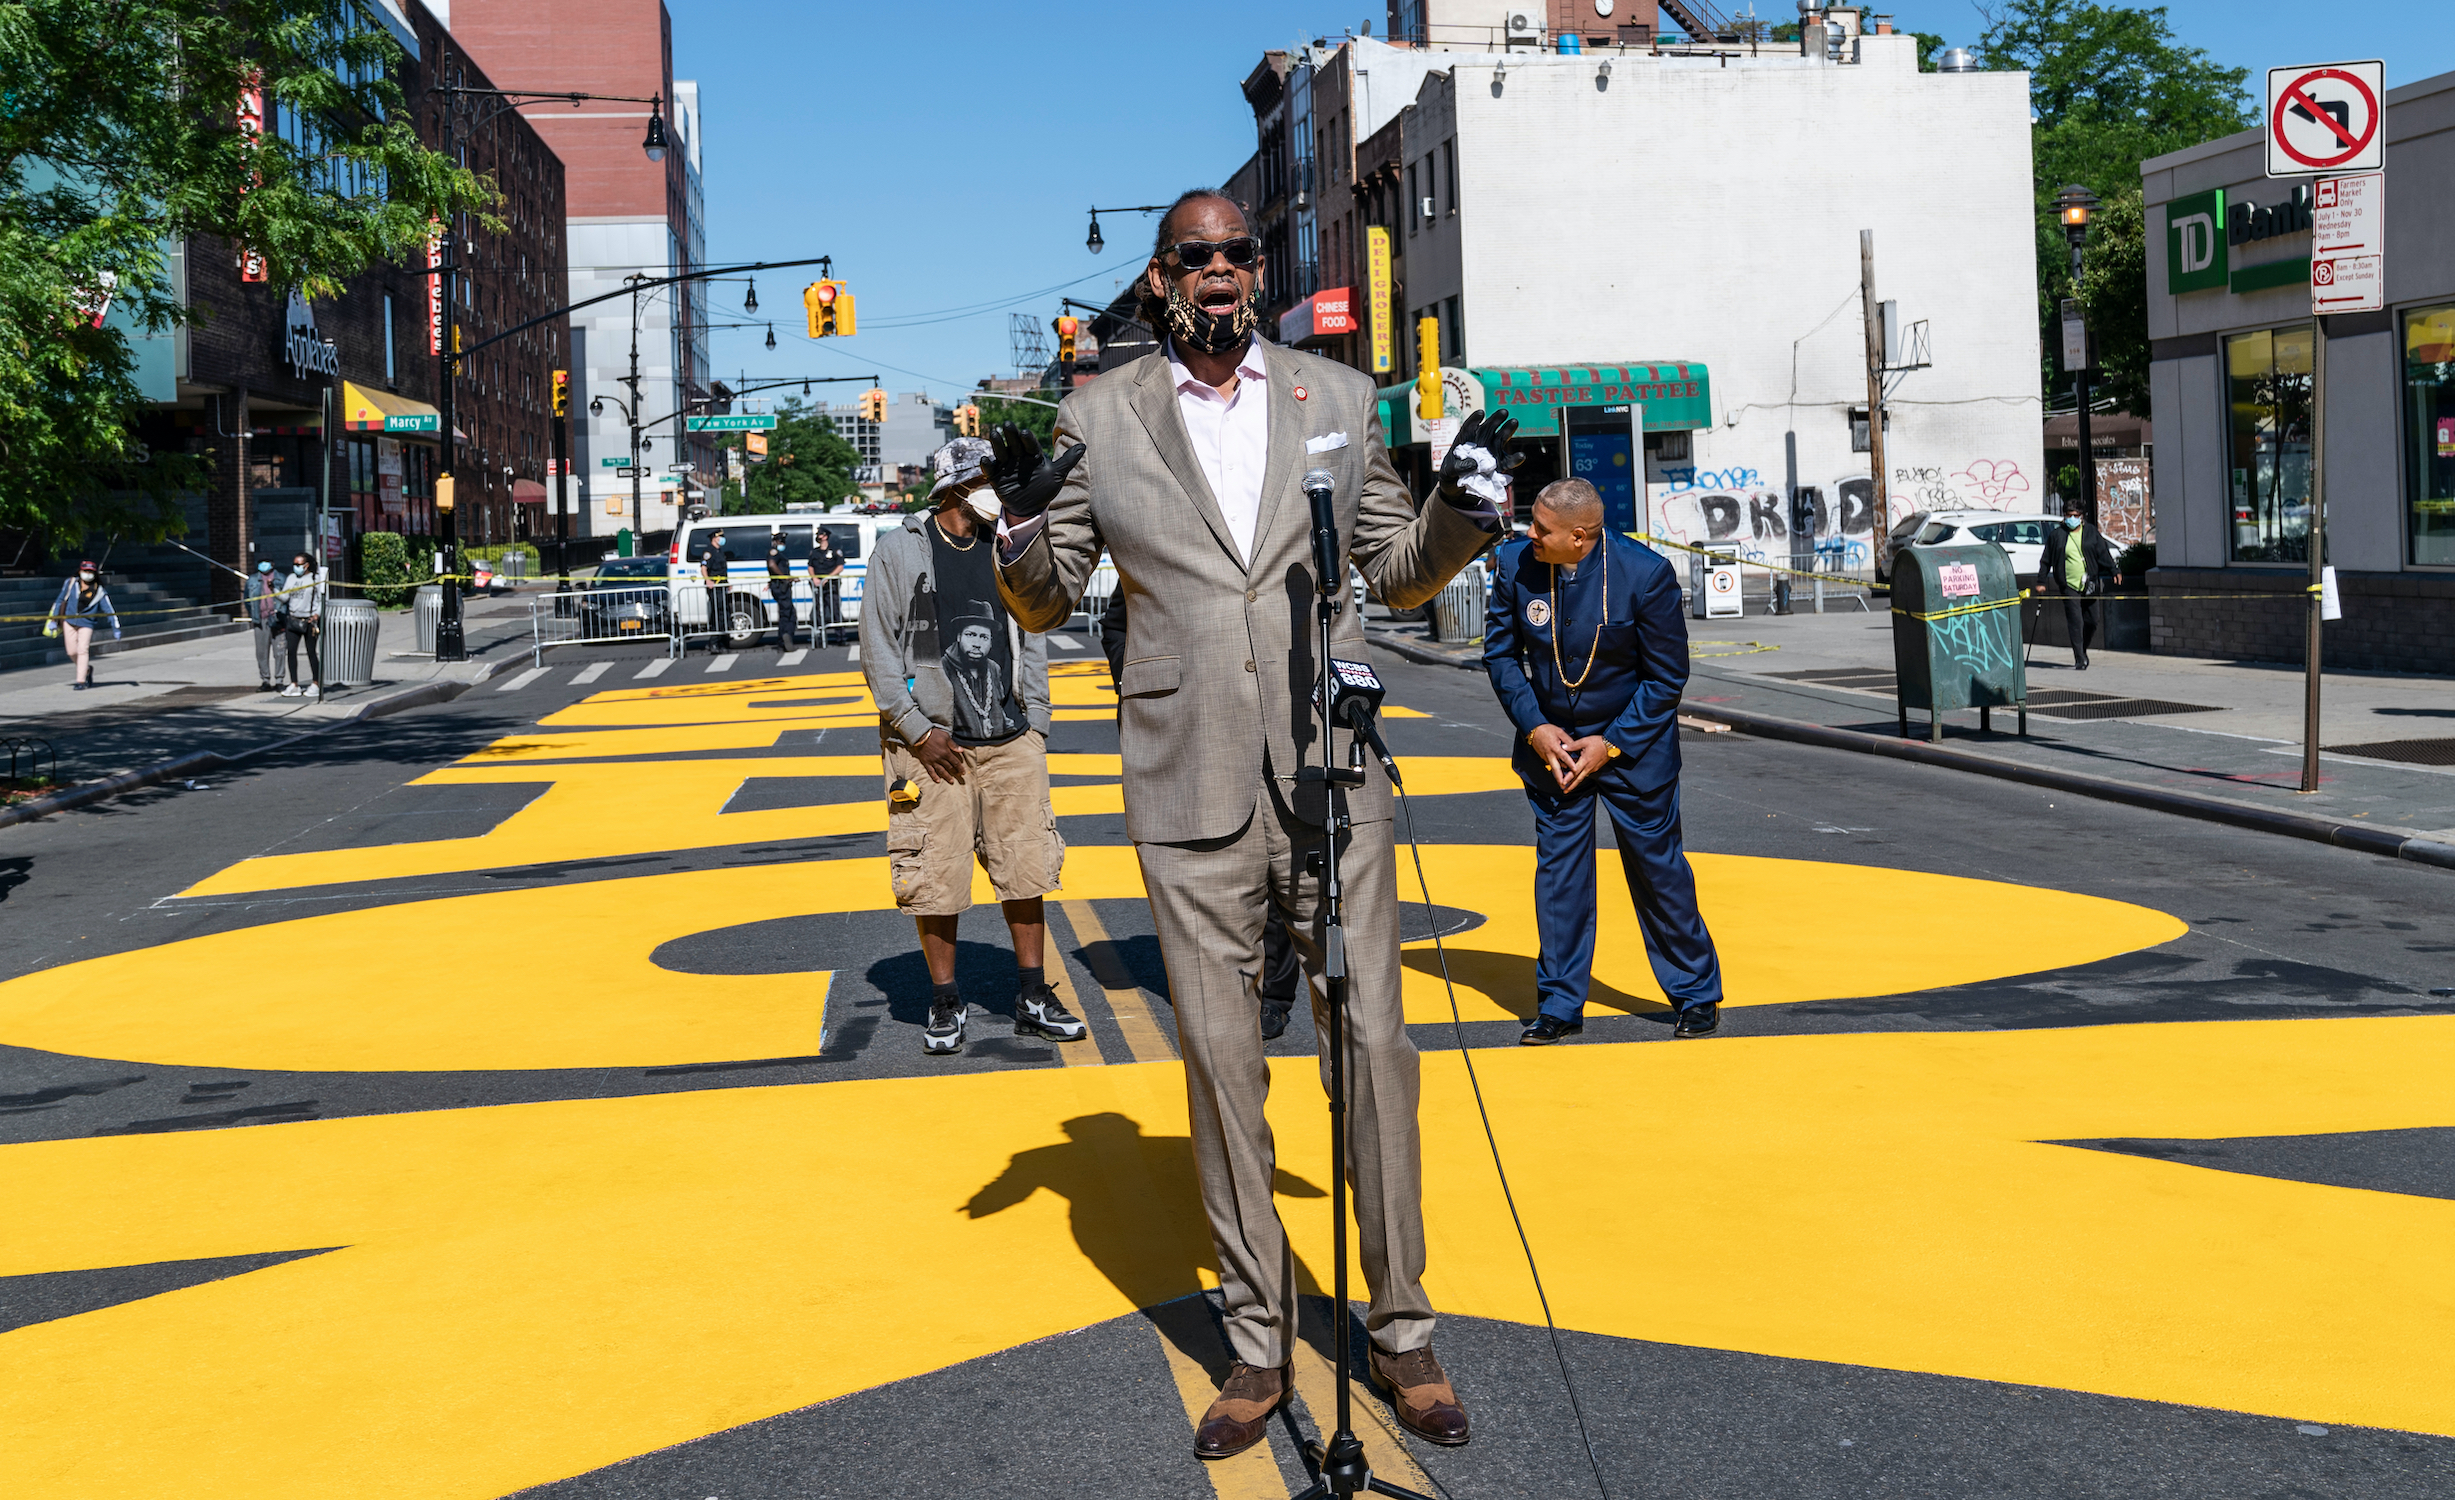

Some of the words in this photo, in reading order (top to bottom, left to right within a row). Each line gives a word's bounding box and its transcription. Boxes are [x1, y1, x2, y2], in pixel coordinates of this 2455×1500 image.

[2340, 179, 2366, 189] Farmers
[2340, 188, 2362, 197] Market
[2340, 198, 2354, 207] Only
[2318, 212, 2331, 221] July
[2354, 208, 2363, 216] 30
[2171, 212, 2214, 274] TD
[2229, 184, 2313, 247] Bank
[2318, 220, 2351, 231] Wednesday
[2337, 231, 2350, 239] 8pm
[2337, 264, 2348, 272] 8am
[2353, 262, 2373, 270] 8:30am
[2337, 273, 2354, 282] Except
[2355, 272, 2374, 281] Sunday
[1316, 300, 1349, 313] CHINESE
[1322, 316, 1347, 328] FOOD
[1446, 372, 1472, 409] PATTEE
[1494, 386, 1593, 406] TASTEE
[1603, 381, 1700, 402] PATTEE
[1604, 405, 1629, 414] LinkNYC
[390, 416, 421, 430] Marcy
[723, 419, 748, 427] York
[751, 418, 765, 426] Av
[2090, 435, 2116, 446] ssociates
[1574, 442, 1594, 451] Today
[1575, 458, 1599, 472] 63°
[1951, 566, 1963, 574] NO
[1943, 574, 1975, 583] PARKING
[1943, 583, 1977, 592] SATURDAY
[1332, 660, 1371, 673] WCBS
[1339, 672, 1381, 689] 880
